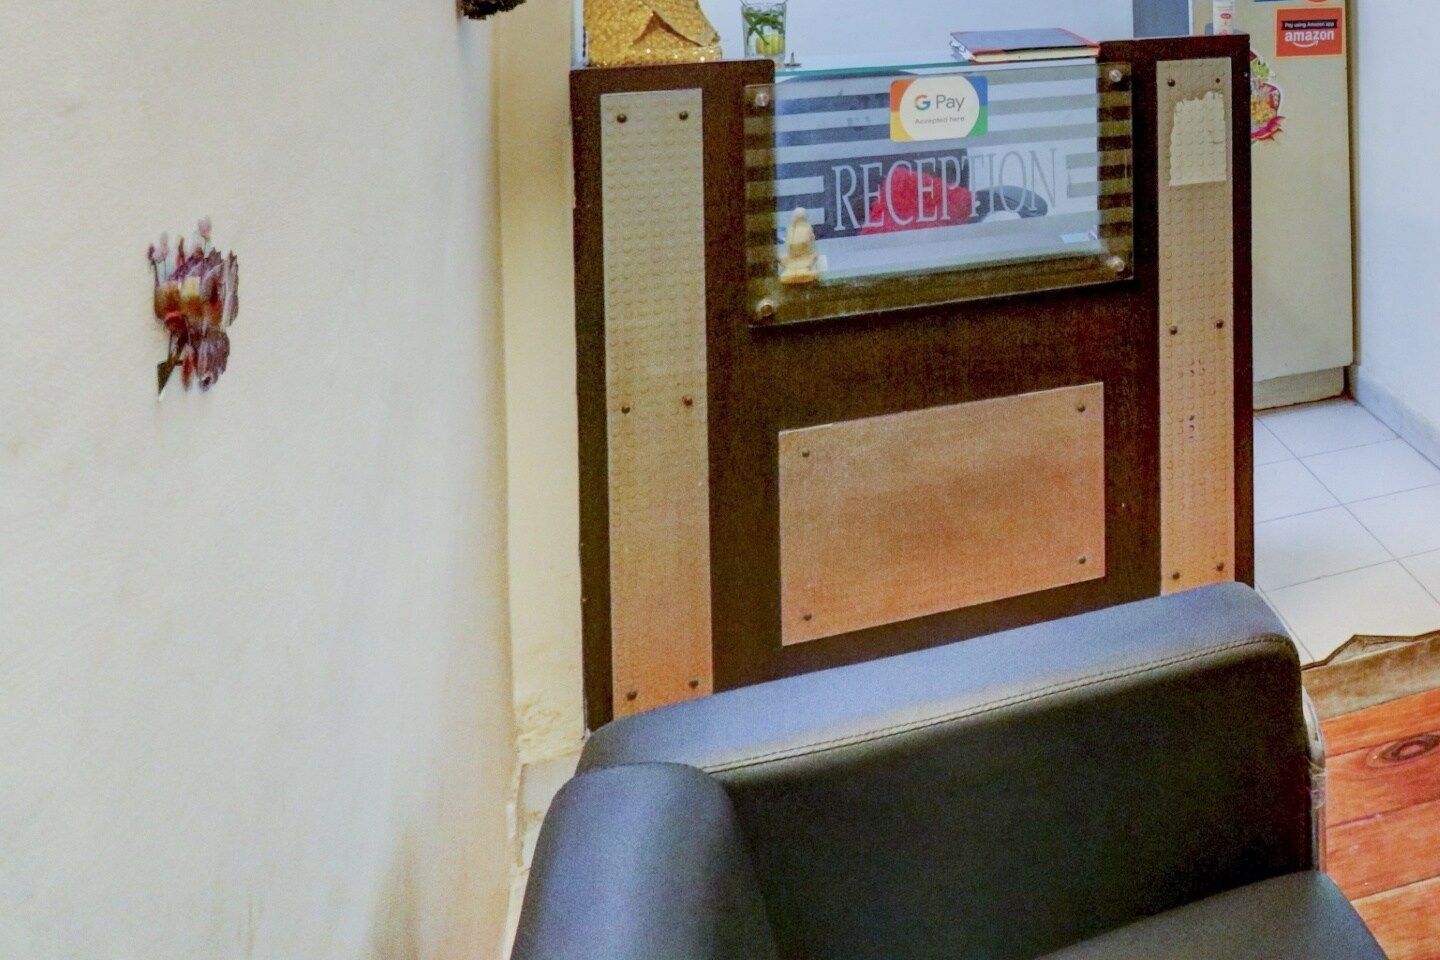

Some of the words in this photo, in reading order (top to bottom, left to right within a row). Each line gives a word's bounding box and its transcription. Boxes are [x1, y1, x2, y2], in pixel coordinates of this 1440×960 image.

[1284, 30, 1335, 42] amazon
[914, 94, 931, 111] G
[936, 94, 965, 111] Pay
[832, 148, 1057, 231] RECEPTION
